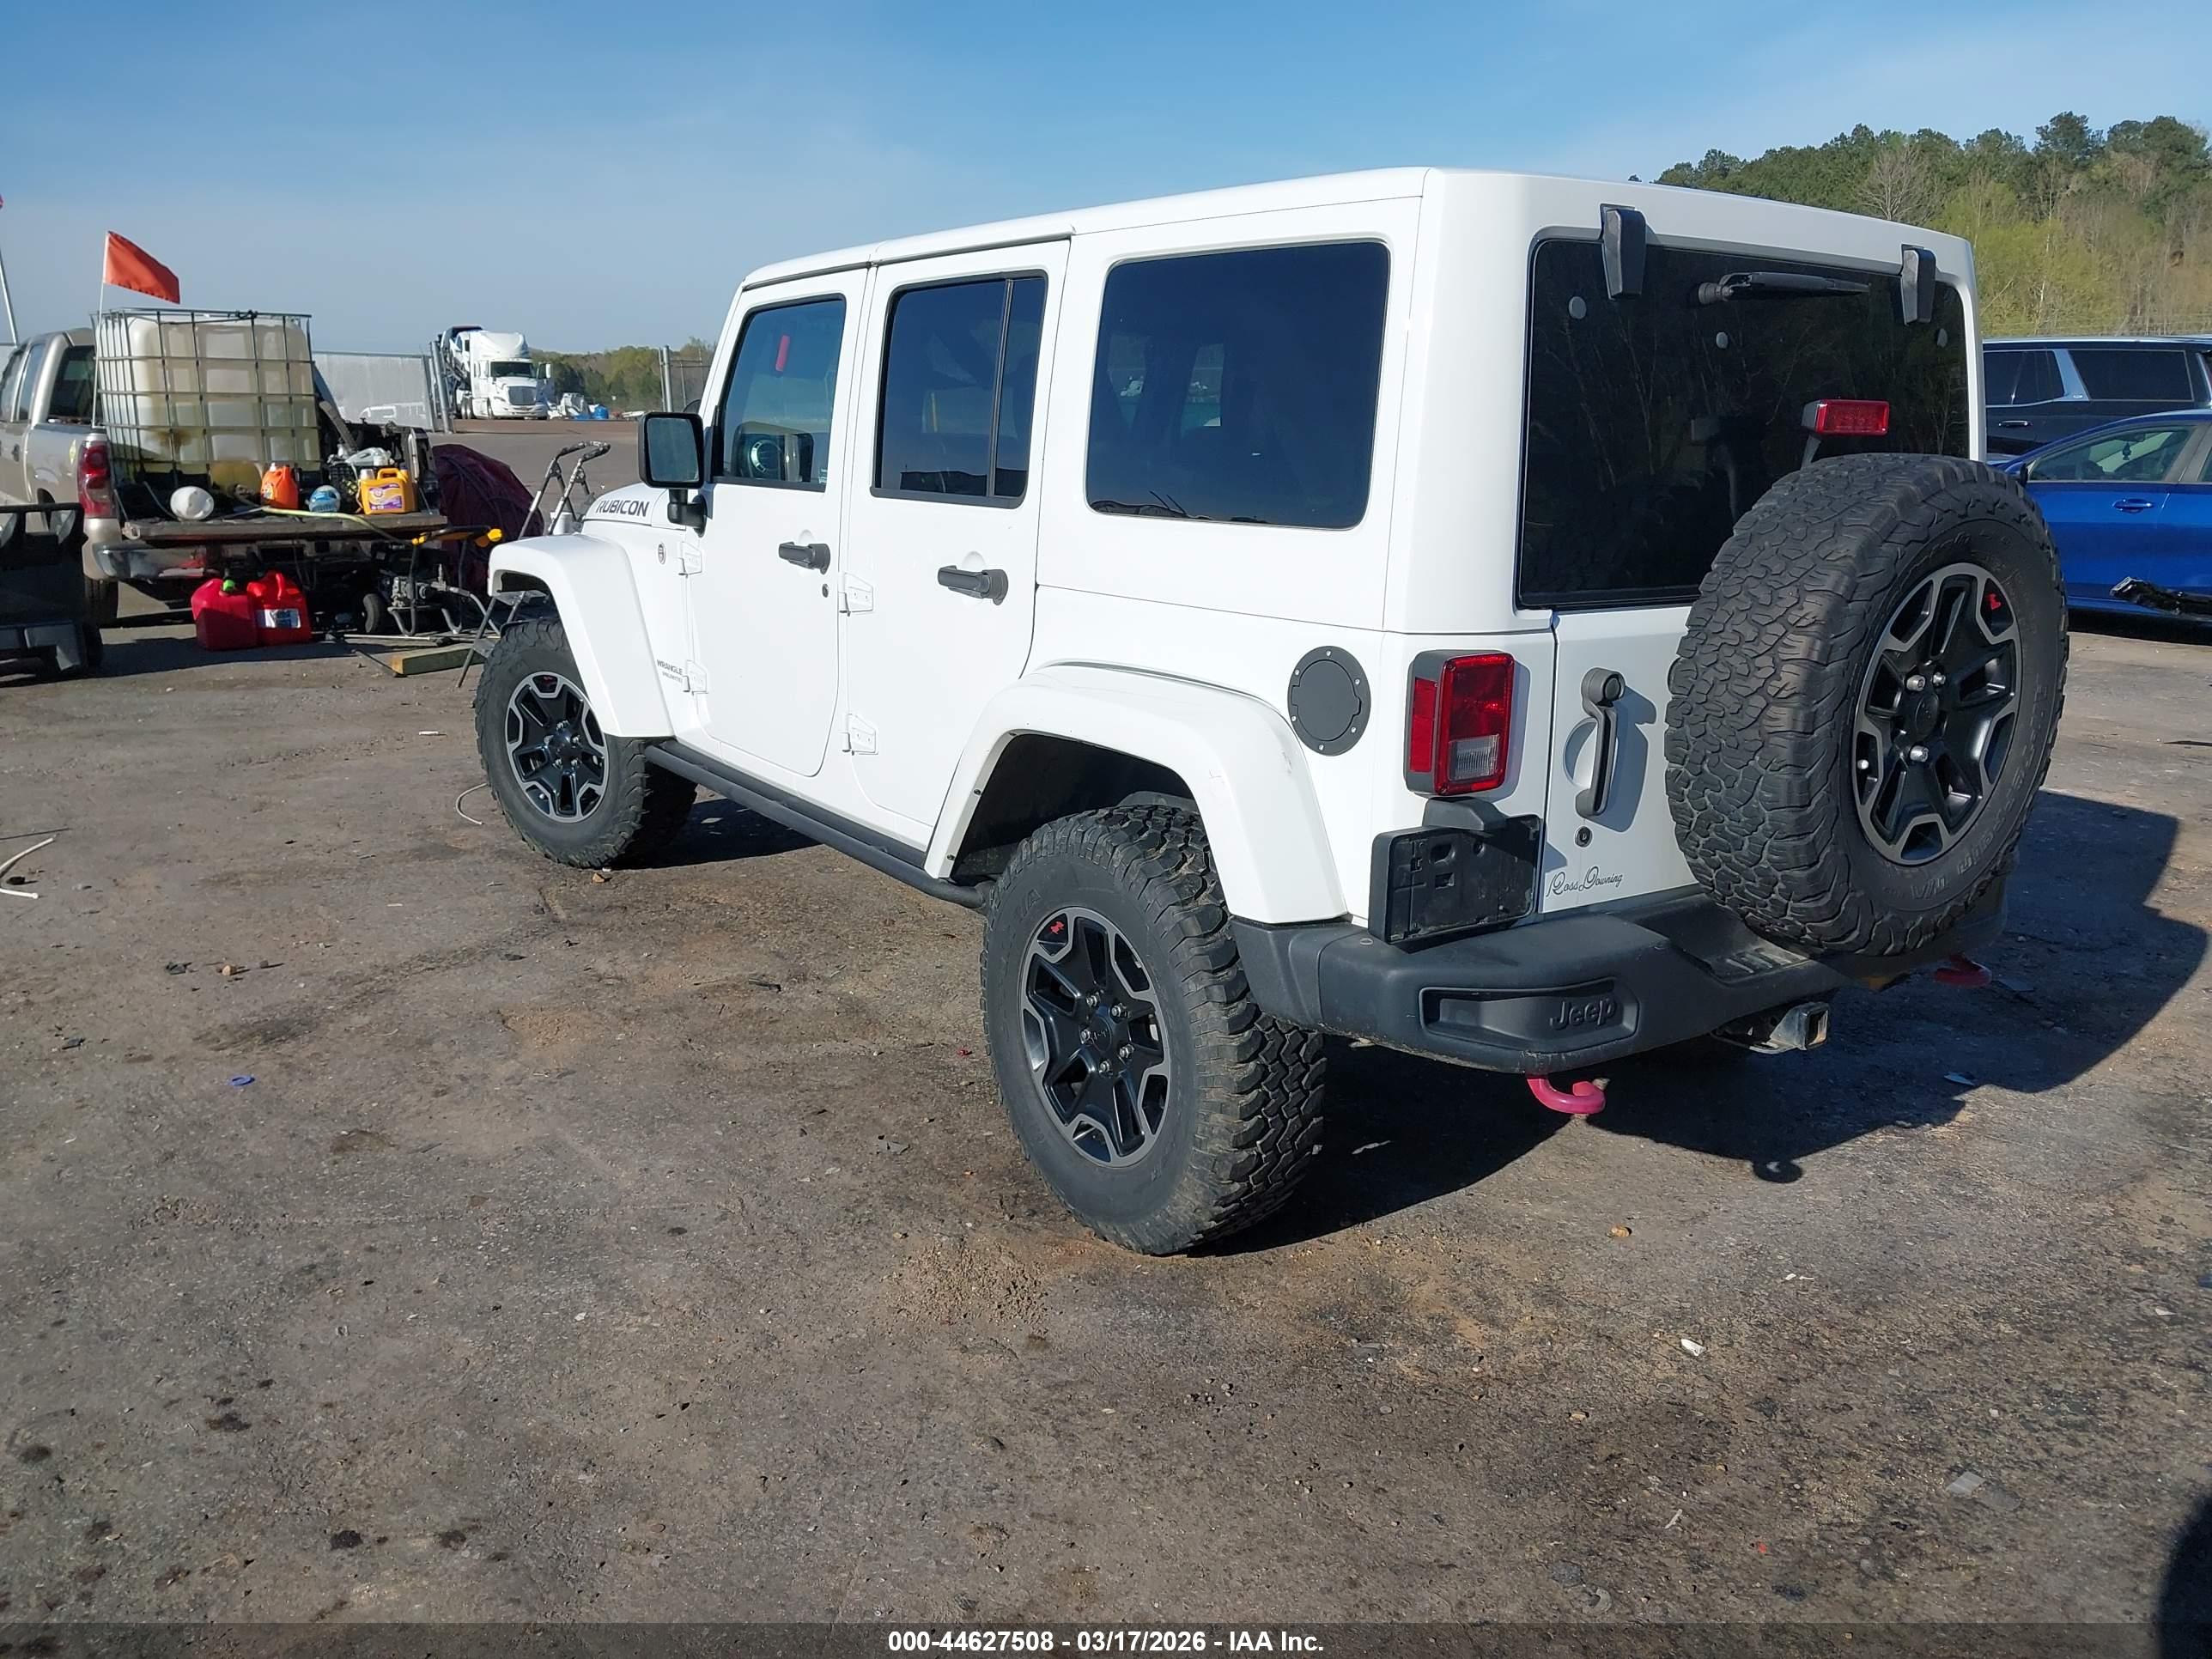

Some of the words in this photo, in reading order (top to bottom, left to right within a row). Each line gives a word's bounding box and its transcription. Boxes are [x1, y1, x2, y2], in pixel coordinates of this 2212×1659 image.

[596, 500, 650, 517] RUBICON
[1546, 872, 1578, 897] Ross
[1578, 866, 1623, 892] Downing
[1549, 998, 1618, 1030] Jeep
